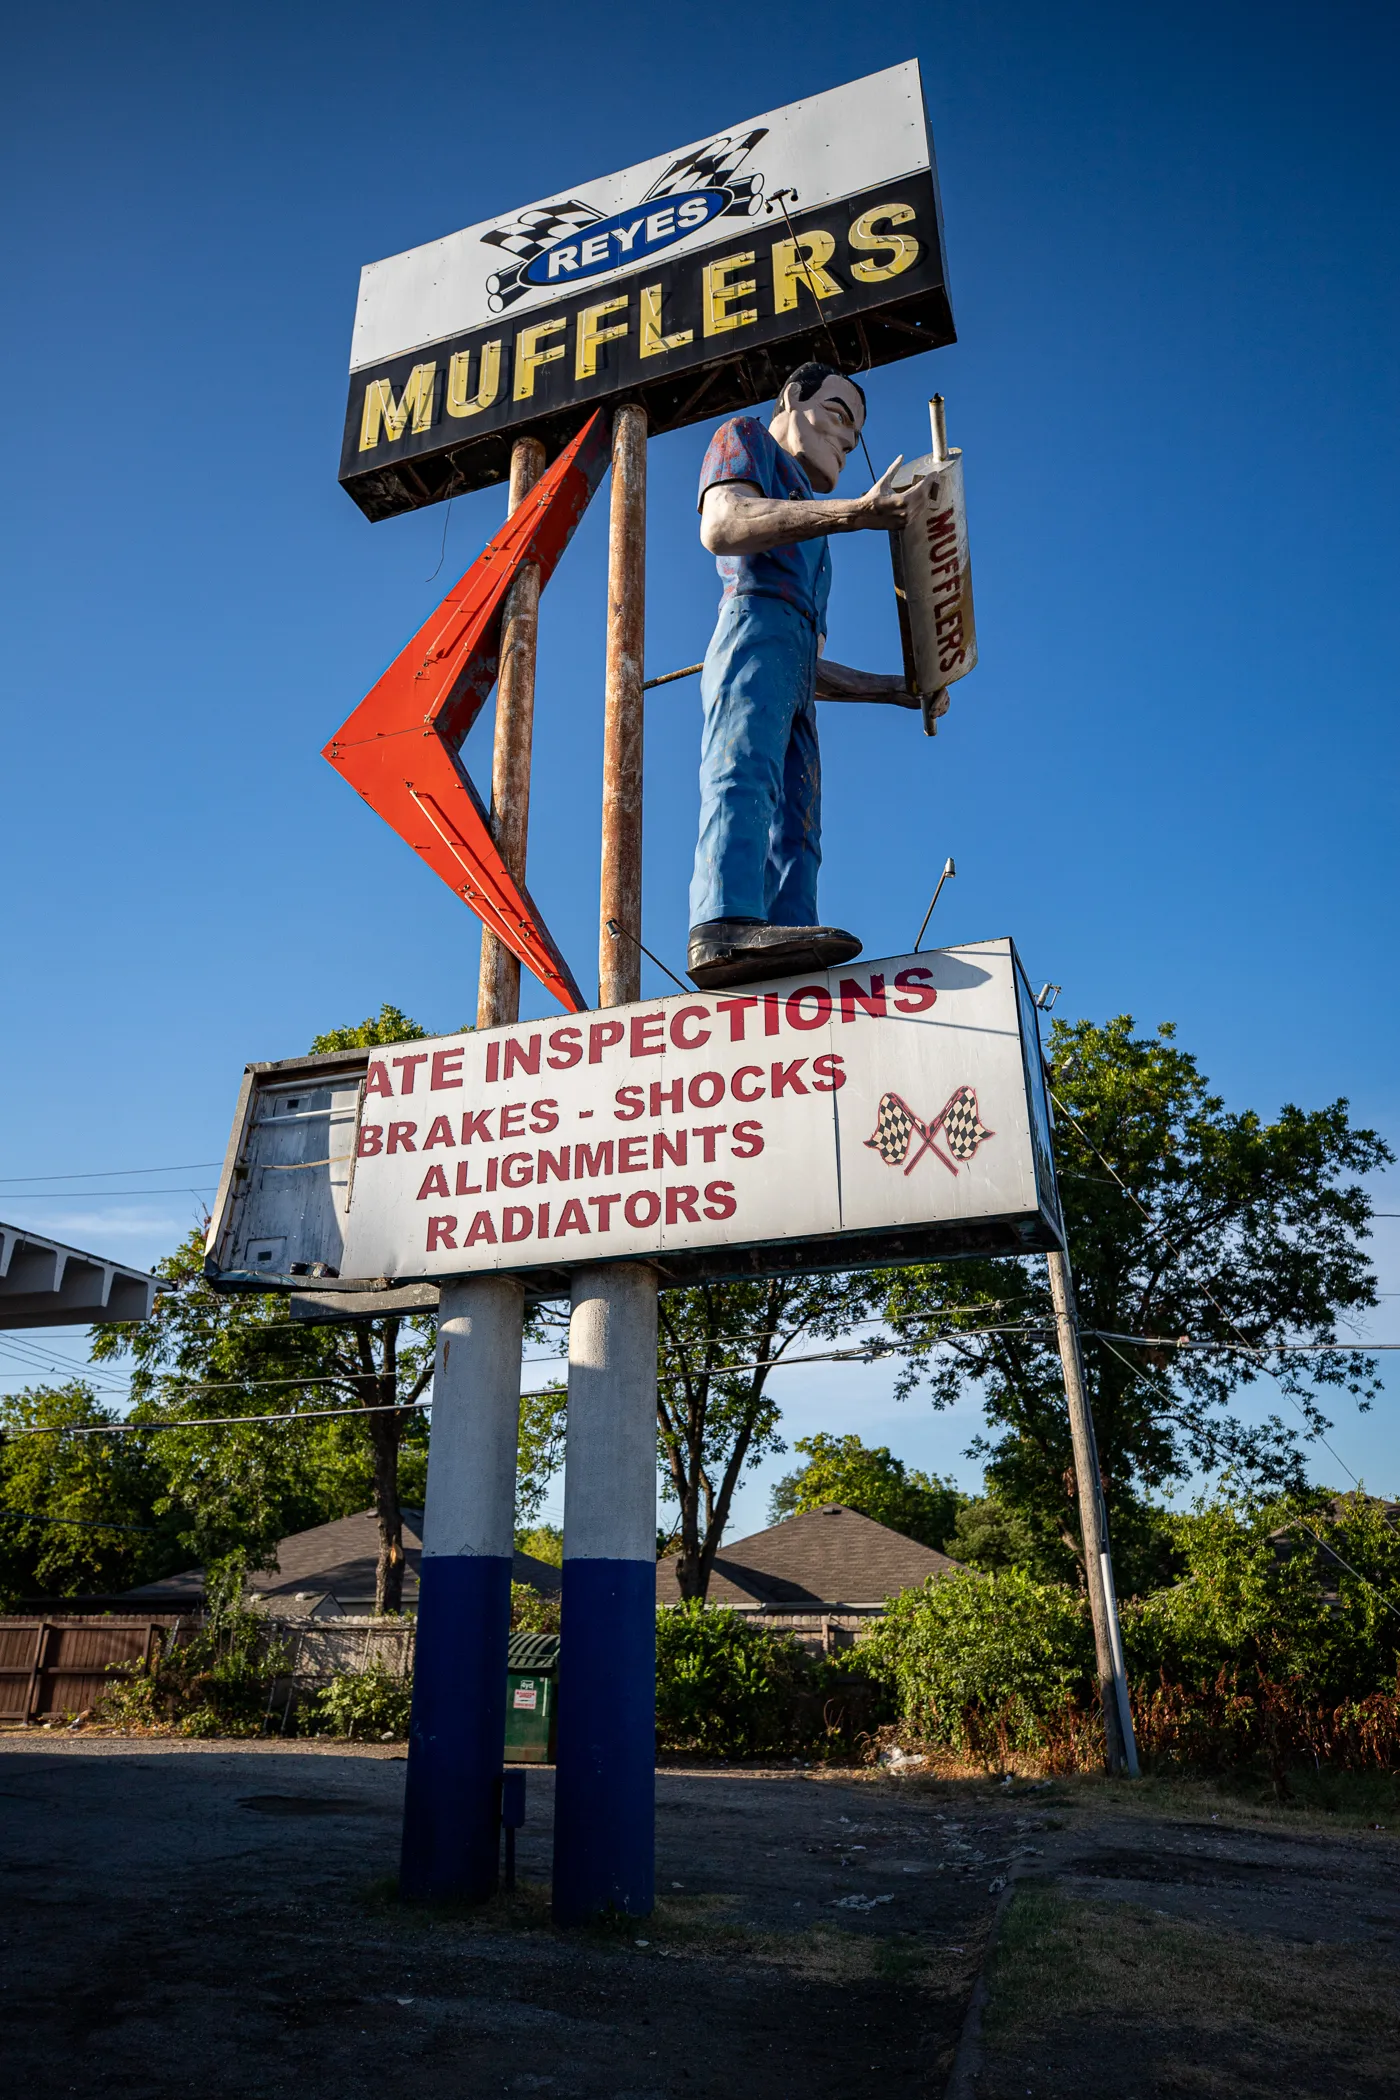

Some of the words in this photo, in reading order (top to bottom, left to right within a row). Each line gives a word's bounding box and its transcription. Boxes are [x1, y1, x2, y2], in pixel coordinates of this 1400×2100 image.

[547, 196, 709, 278] REYES
[358, 203, 920, 452] MUFFLERS
[927, 508, 966, 673] MUFFLERS
[365, 1048, 464, 1098] ATE
[485, 967, 937, 1082] INSPECTIONS
[357, 1098, 559, 1158] BRAKES
[614, 1053, 847, 1121] SHOCKS
[416, 1119, 764, 1200] ALIGNMENTS
[426, 1180, 737, 1252] RADIATORS
